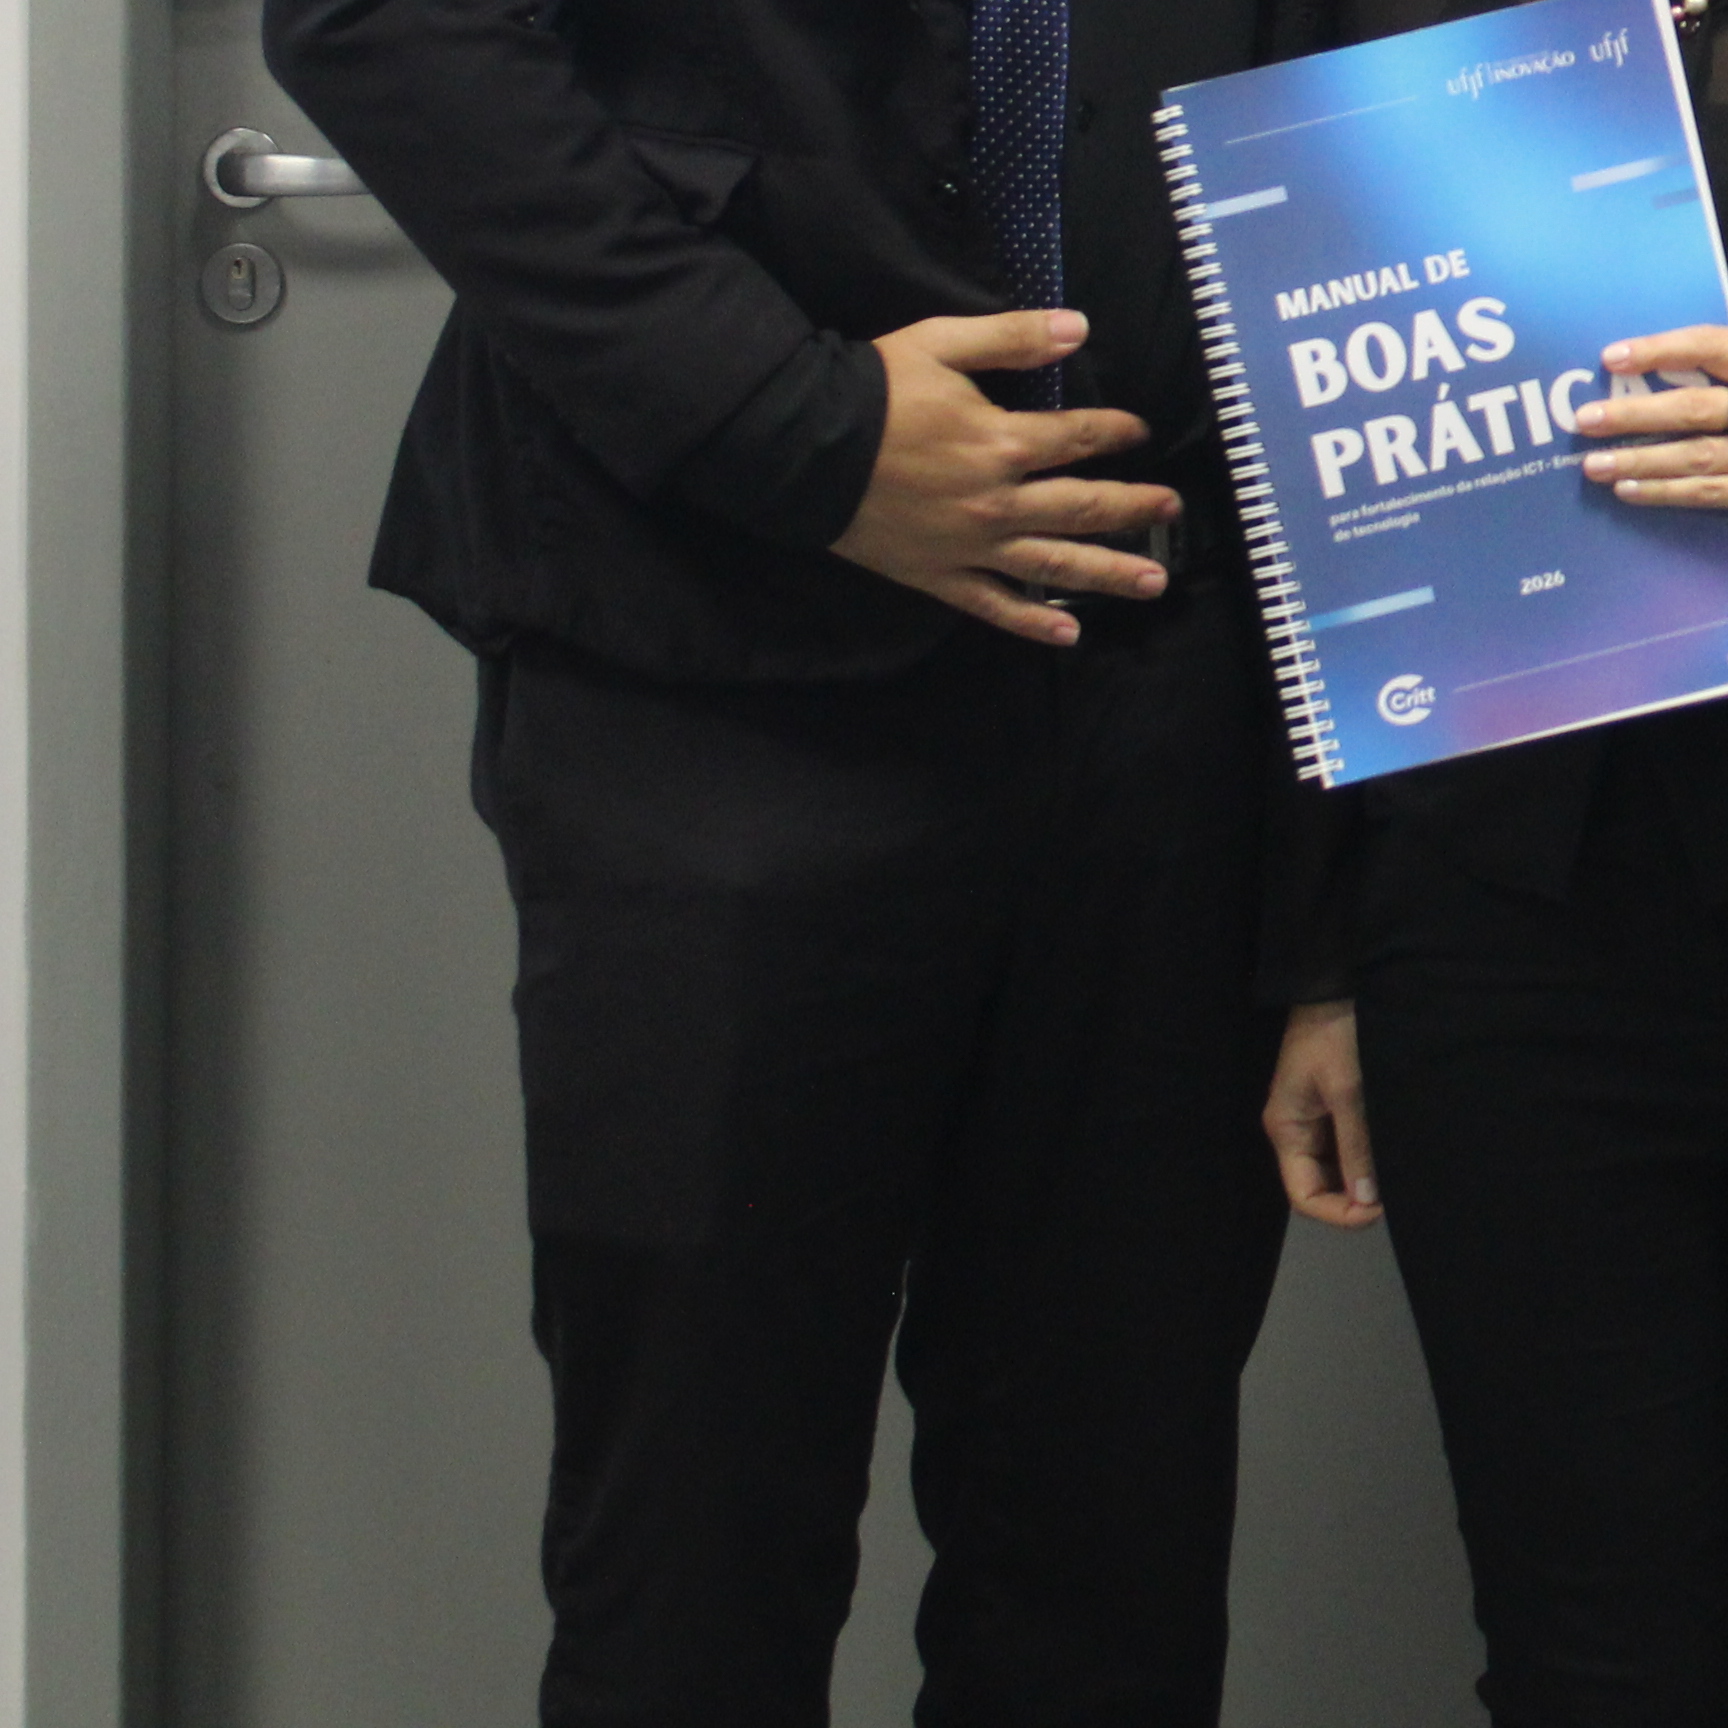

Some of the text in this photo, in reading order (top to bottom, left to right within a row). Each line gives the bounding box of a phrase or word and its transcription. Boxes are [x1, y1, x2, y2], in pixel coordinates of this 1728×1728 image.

[1275, 248, 1470, 321] MANUAL DE
[1288, 296, 1516, 409] BOAS
[1519, 569, 1566, 596] 2026
